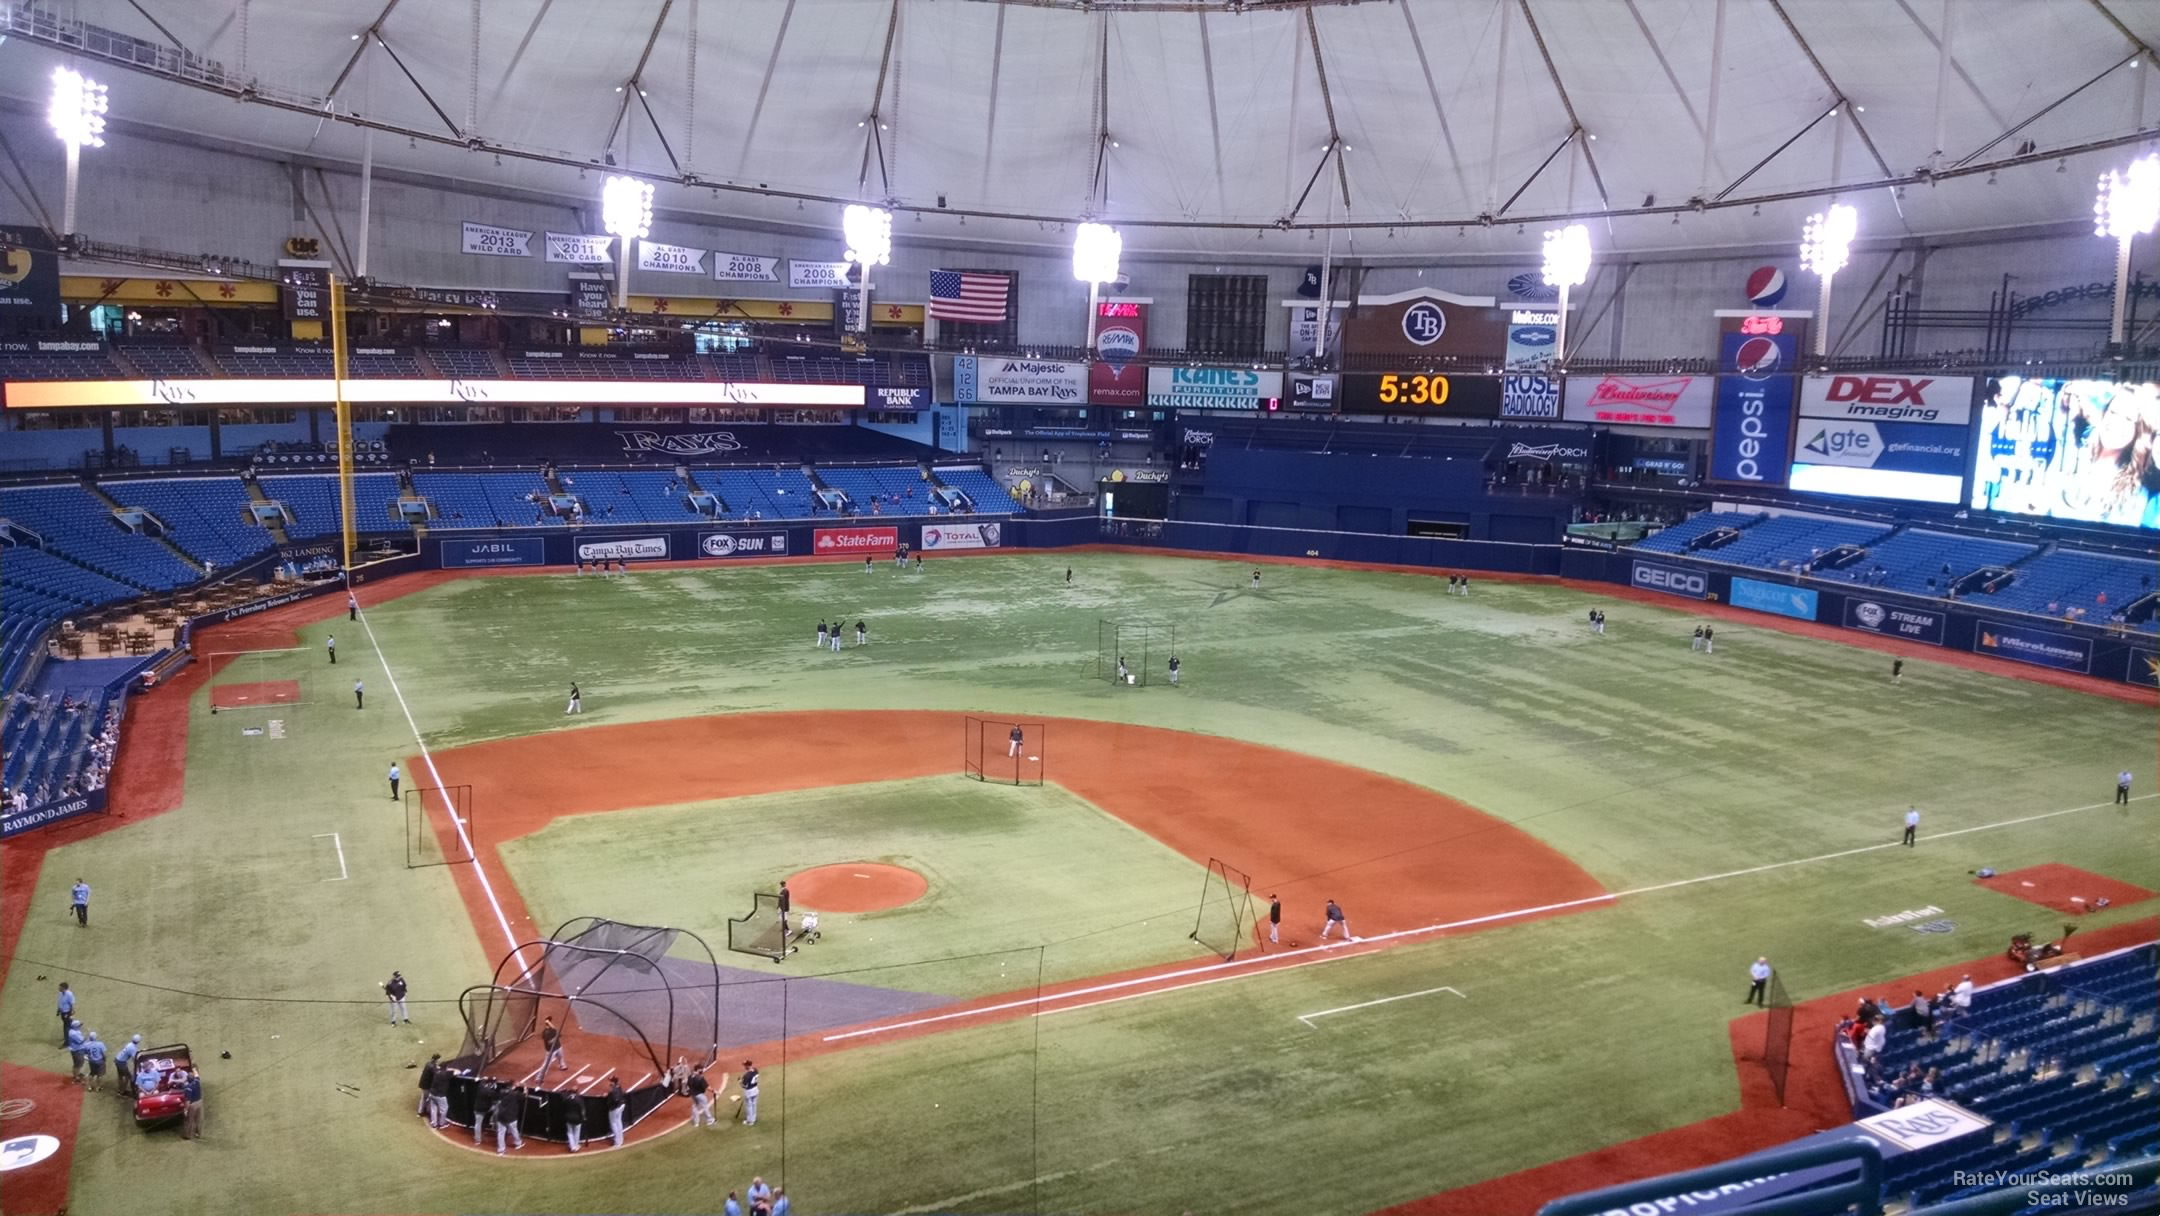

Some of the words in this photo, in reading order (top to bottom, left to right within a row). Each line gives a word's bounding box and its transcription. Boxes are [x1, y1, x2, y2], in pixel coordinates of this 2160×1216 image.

[465, 226, 500, 235] AMERICAN
[502, 230, 528, 238] LEAGUE
[480, 234, 514, 248] 2013
[470, 244, 493, 252] WILD
[497, 247, 522, 255] CARD
[562, 243, 594, 254] 2011
[554, 252, 574, 260] WILD
[654, 252, 688, 264] 2010
[643, 260, 696, 272] CHAMPIONS
[729, 262, 762, 272] 2008
[720, 271, 770, 280] CHAMPIONS
[804, 269, 836, 278] 2008
[580, 282, 605, 291] Have
[297, 290, 316, 300] you
[578, 299, 608, 308] heard
[1411, 310, 1438, 337] TB
[1102, 334, 1134, 345] RE/MAX
[38, 340, 100, 352] tampabay.com
[234, 346, 276, 354] tampabay.com
[958, 358, 973, 369] 42
[1020, 362, 1064, 375] Majestic
[960, 374, 972, 384] 12
[1172, 368, 1259, 385] KANES
[1505, 370, 1558, 395] ROSE
[878, 388, 920, 397] REPUBLIC
[958, 388, 972, 399] 66
[989, 386, 1026, 396] TAMPA
[1028, 387, 1049, 396] BAY
[1094, 388, 1140, 397] remax.com
[1175, 386, 1254, 394] FURNITURE
[1380, 375, 1449, 405] 5:30
[1596, 384, 1679, 401] Budweiser
[1825, 376, 1935, 405] DEX
[886, 396, 912, 405] BANK
[1504, 395, 1557, 416] RADIOLOGY
[1848, 403, 1939, 420] imaging
[1737, 392, 1767, 480] pepsi
[1830, 429, 1870, 451] gte
[614, 430, 742, 456] RAYS
[1512, 444, 1554, 456] Budweiser
[1554, 447, 1587, 457] PORCH
[1888, 443, 1960, 456] gtefinancial.org
[1008, 468, 1040, 477] Ducky's
[1135, 470, 1168, 482] Ducky's
[472, 544, 515, 553] JABIL
[583, 547, 613, 556] Tampa
[615, 545, 634, 556] Bay
[635, 543, 663, 554] Times
[710, 540, 729, 548] FOX
[738, 538, 764, 550] SUN
[295, 546, 334, 556] LANDING
[1635, 566, 1705, 593] GEICO
[1739, 580, 1788, 601] Sagicor
[239, 602, 267, 615] Petersburg
[1863, 606, 1878, 616] FOX
[1890, 611, 1933, 626] STREAM
[1900, 623, 1921, 634] LIVE
[2002, 637, 2083, 658] MicroLumen
[3, 809, 55, 832] RAYMOND
[56, 800, 88, 817] JAMES
[1875, 1110, 1960, 1140] RAYS
